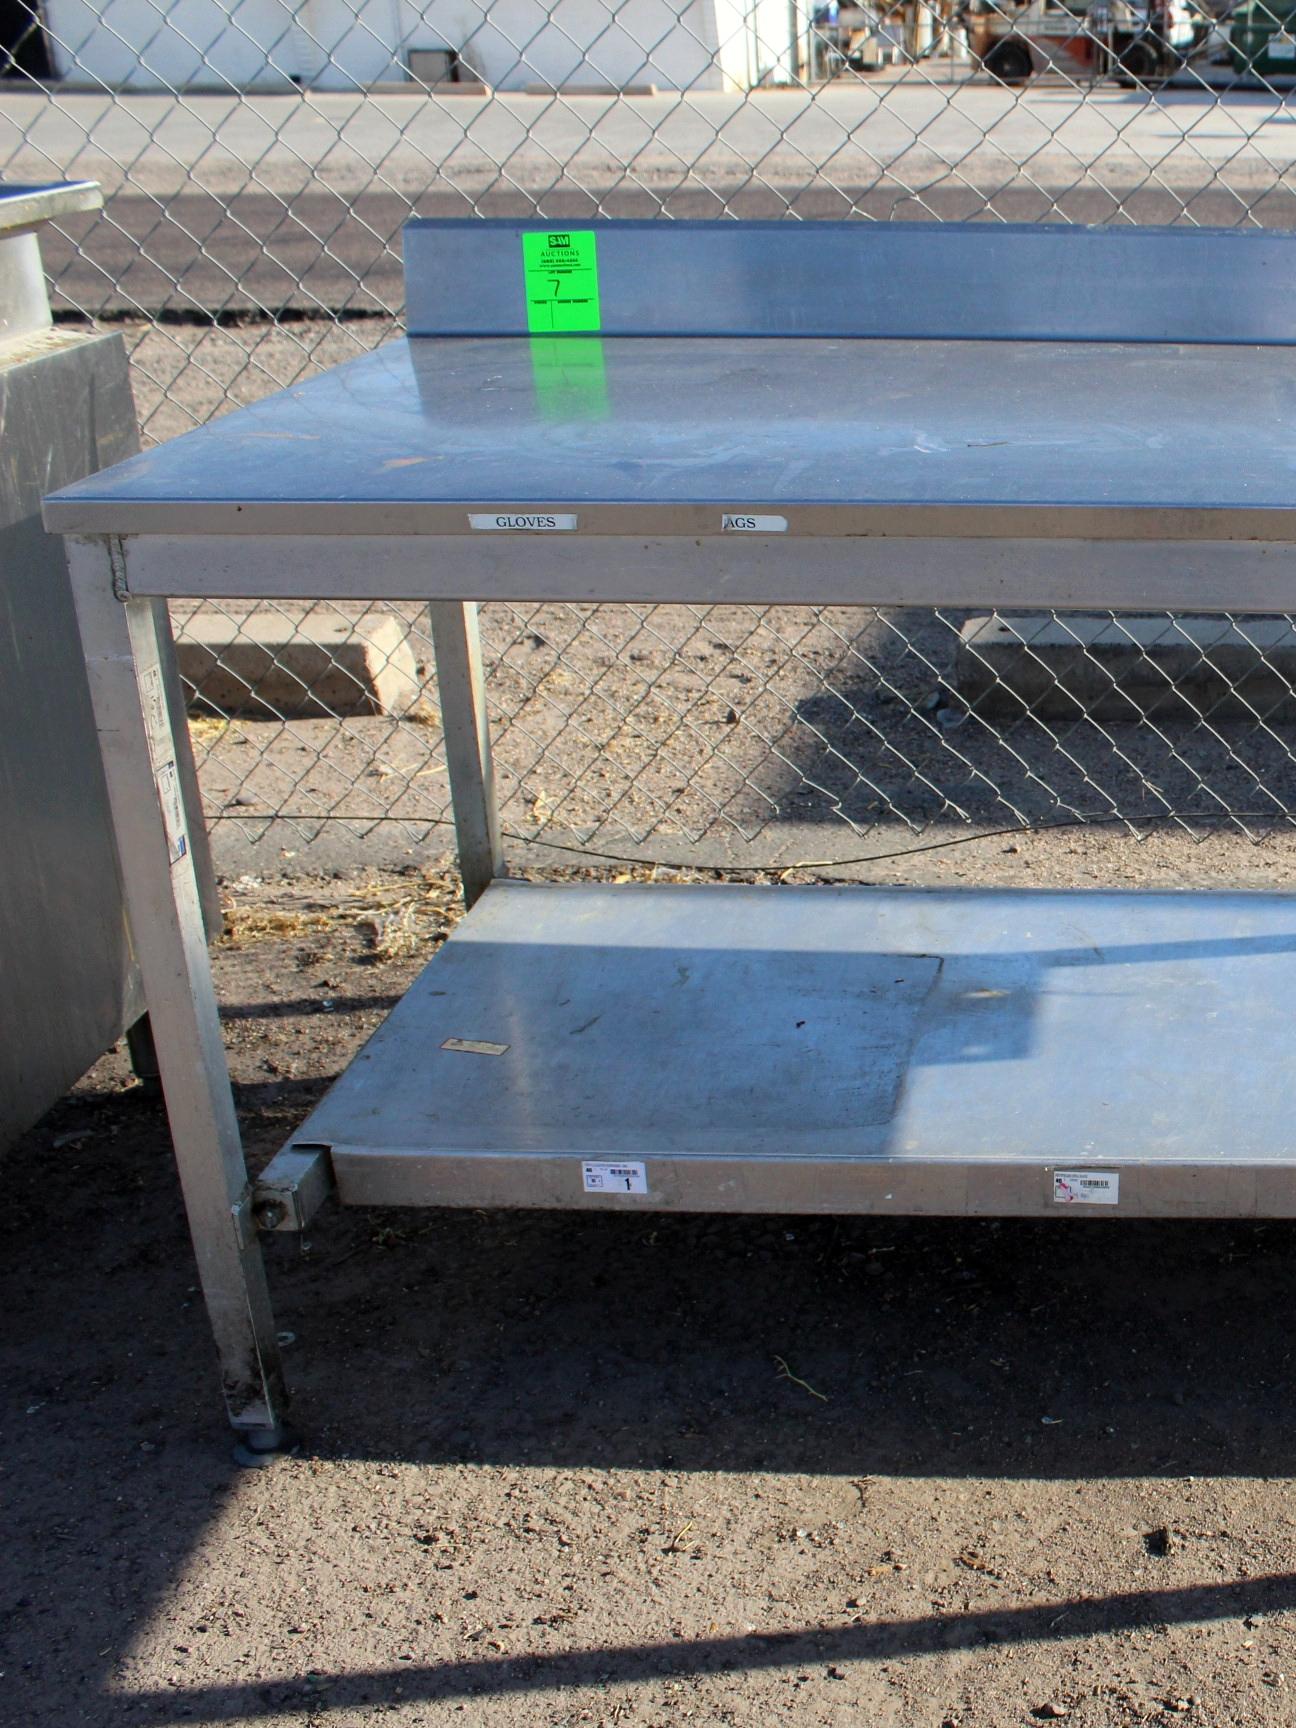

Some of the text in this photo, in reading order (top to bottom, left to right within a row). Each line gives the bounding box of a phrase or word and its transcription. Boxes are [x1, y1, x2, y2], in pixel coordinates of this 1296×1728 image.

[549, 235, 569, 246] SAM
[547, 279, 560, 297] 7
[495, 516, 556, 529] GLOVES
[724, 517, 756, 529] AGS
